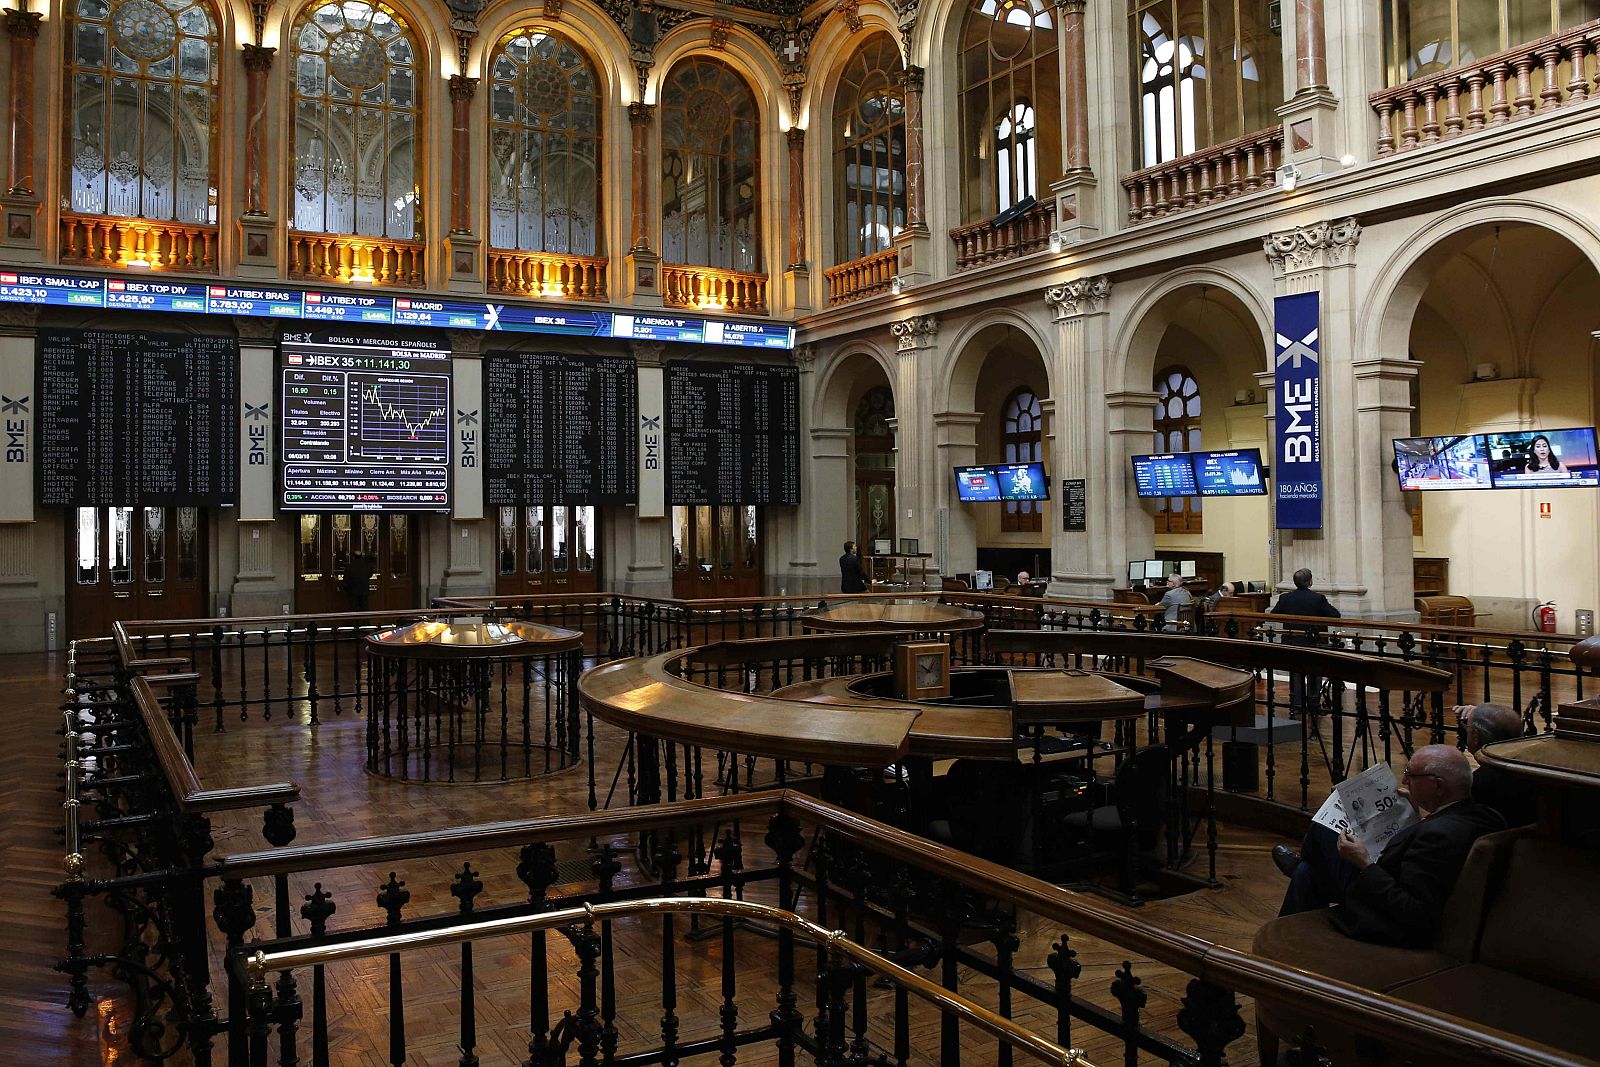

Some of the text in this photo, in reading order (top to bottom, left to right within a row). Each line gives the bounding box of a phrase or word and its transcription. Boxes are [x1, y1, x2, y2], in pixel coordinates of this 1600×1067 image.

[20, 276, 100, 289] IBEX SMALL CAP
[0, 287, 47, 297] 5.423,10
[127, 283, 187, 294] IBEX TOP DIV
[109, 294, 155, 304] 3.425,90
[228, 290, 289, 301] LATIBEX BRAS
[322, 296, 375, 306] LATIBEX TOP
[211, 300, 253, 309] 5.783,00
[412, 302, 443, 311] MADRID
[642, 318, 674, 327] ABENGOA
[283, 333, 302, 342] BME
[363, 338, 399, 346] MERCADOS
[401, 340, 437, 348] ESPAÑOLES
[314, 355, 410, 370] IBEX 35 11.141,30
[1284, 378, 1311, 463] BME
[7, 420, 24, 462] BME
[249, 425, 264, 465] BME
[461, 430, 475, 467] BME
[645, 434, 657, 469] BME
[1280, 482, 1317, 493] 180 AÑOS
